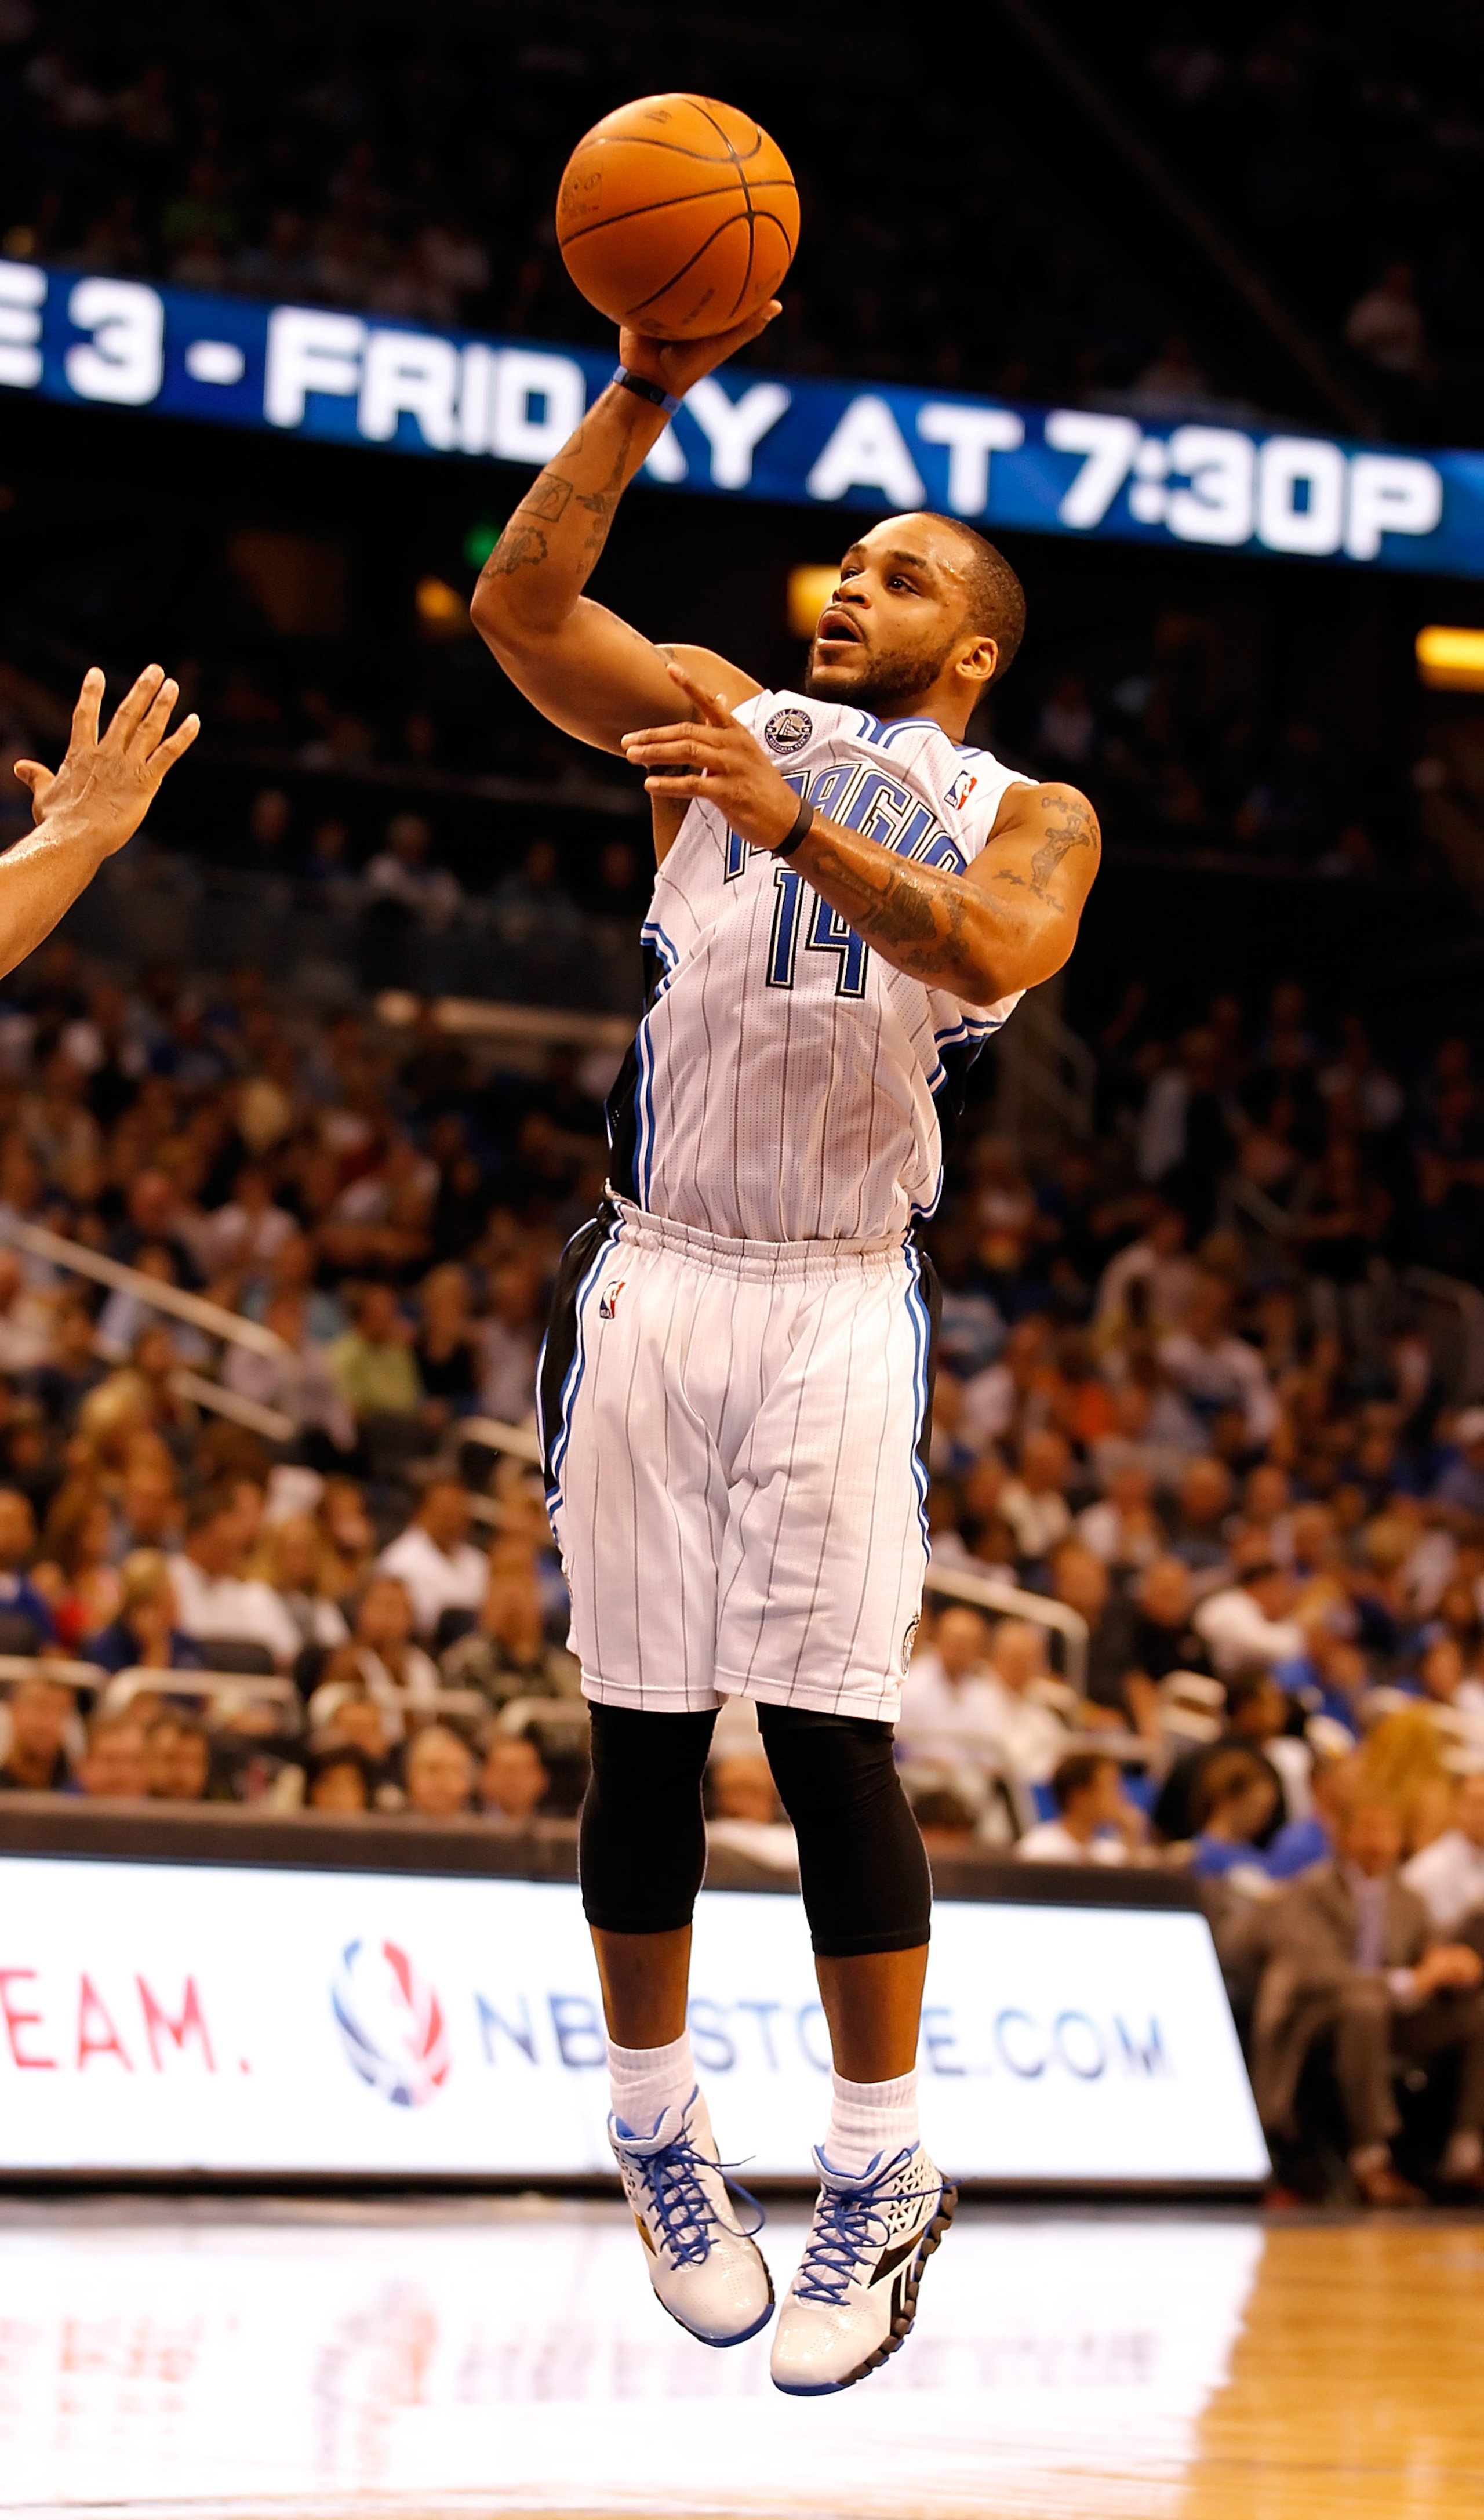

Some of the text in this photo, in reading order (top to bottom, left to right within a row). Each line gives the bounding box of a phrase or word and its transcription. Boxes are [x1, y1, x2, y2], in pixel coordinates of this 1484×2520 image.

[65, 275, 165, 406] 3
[185, 339, 245, 386] -
[806, 394, 1025, 516] AT
[1044, 408, 1443, 561] 7:30P
[766, 866, 871, 998] 14
